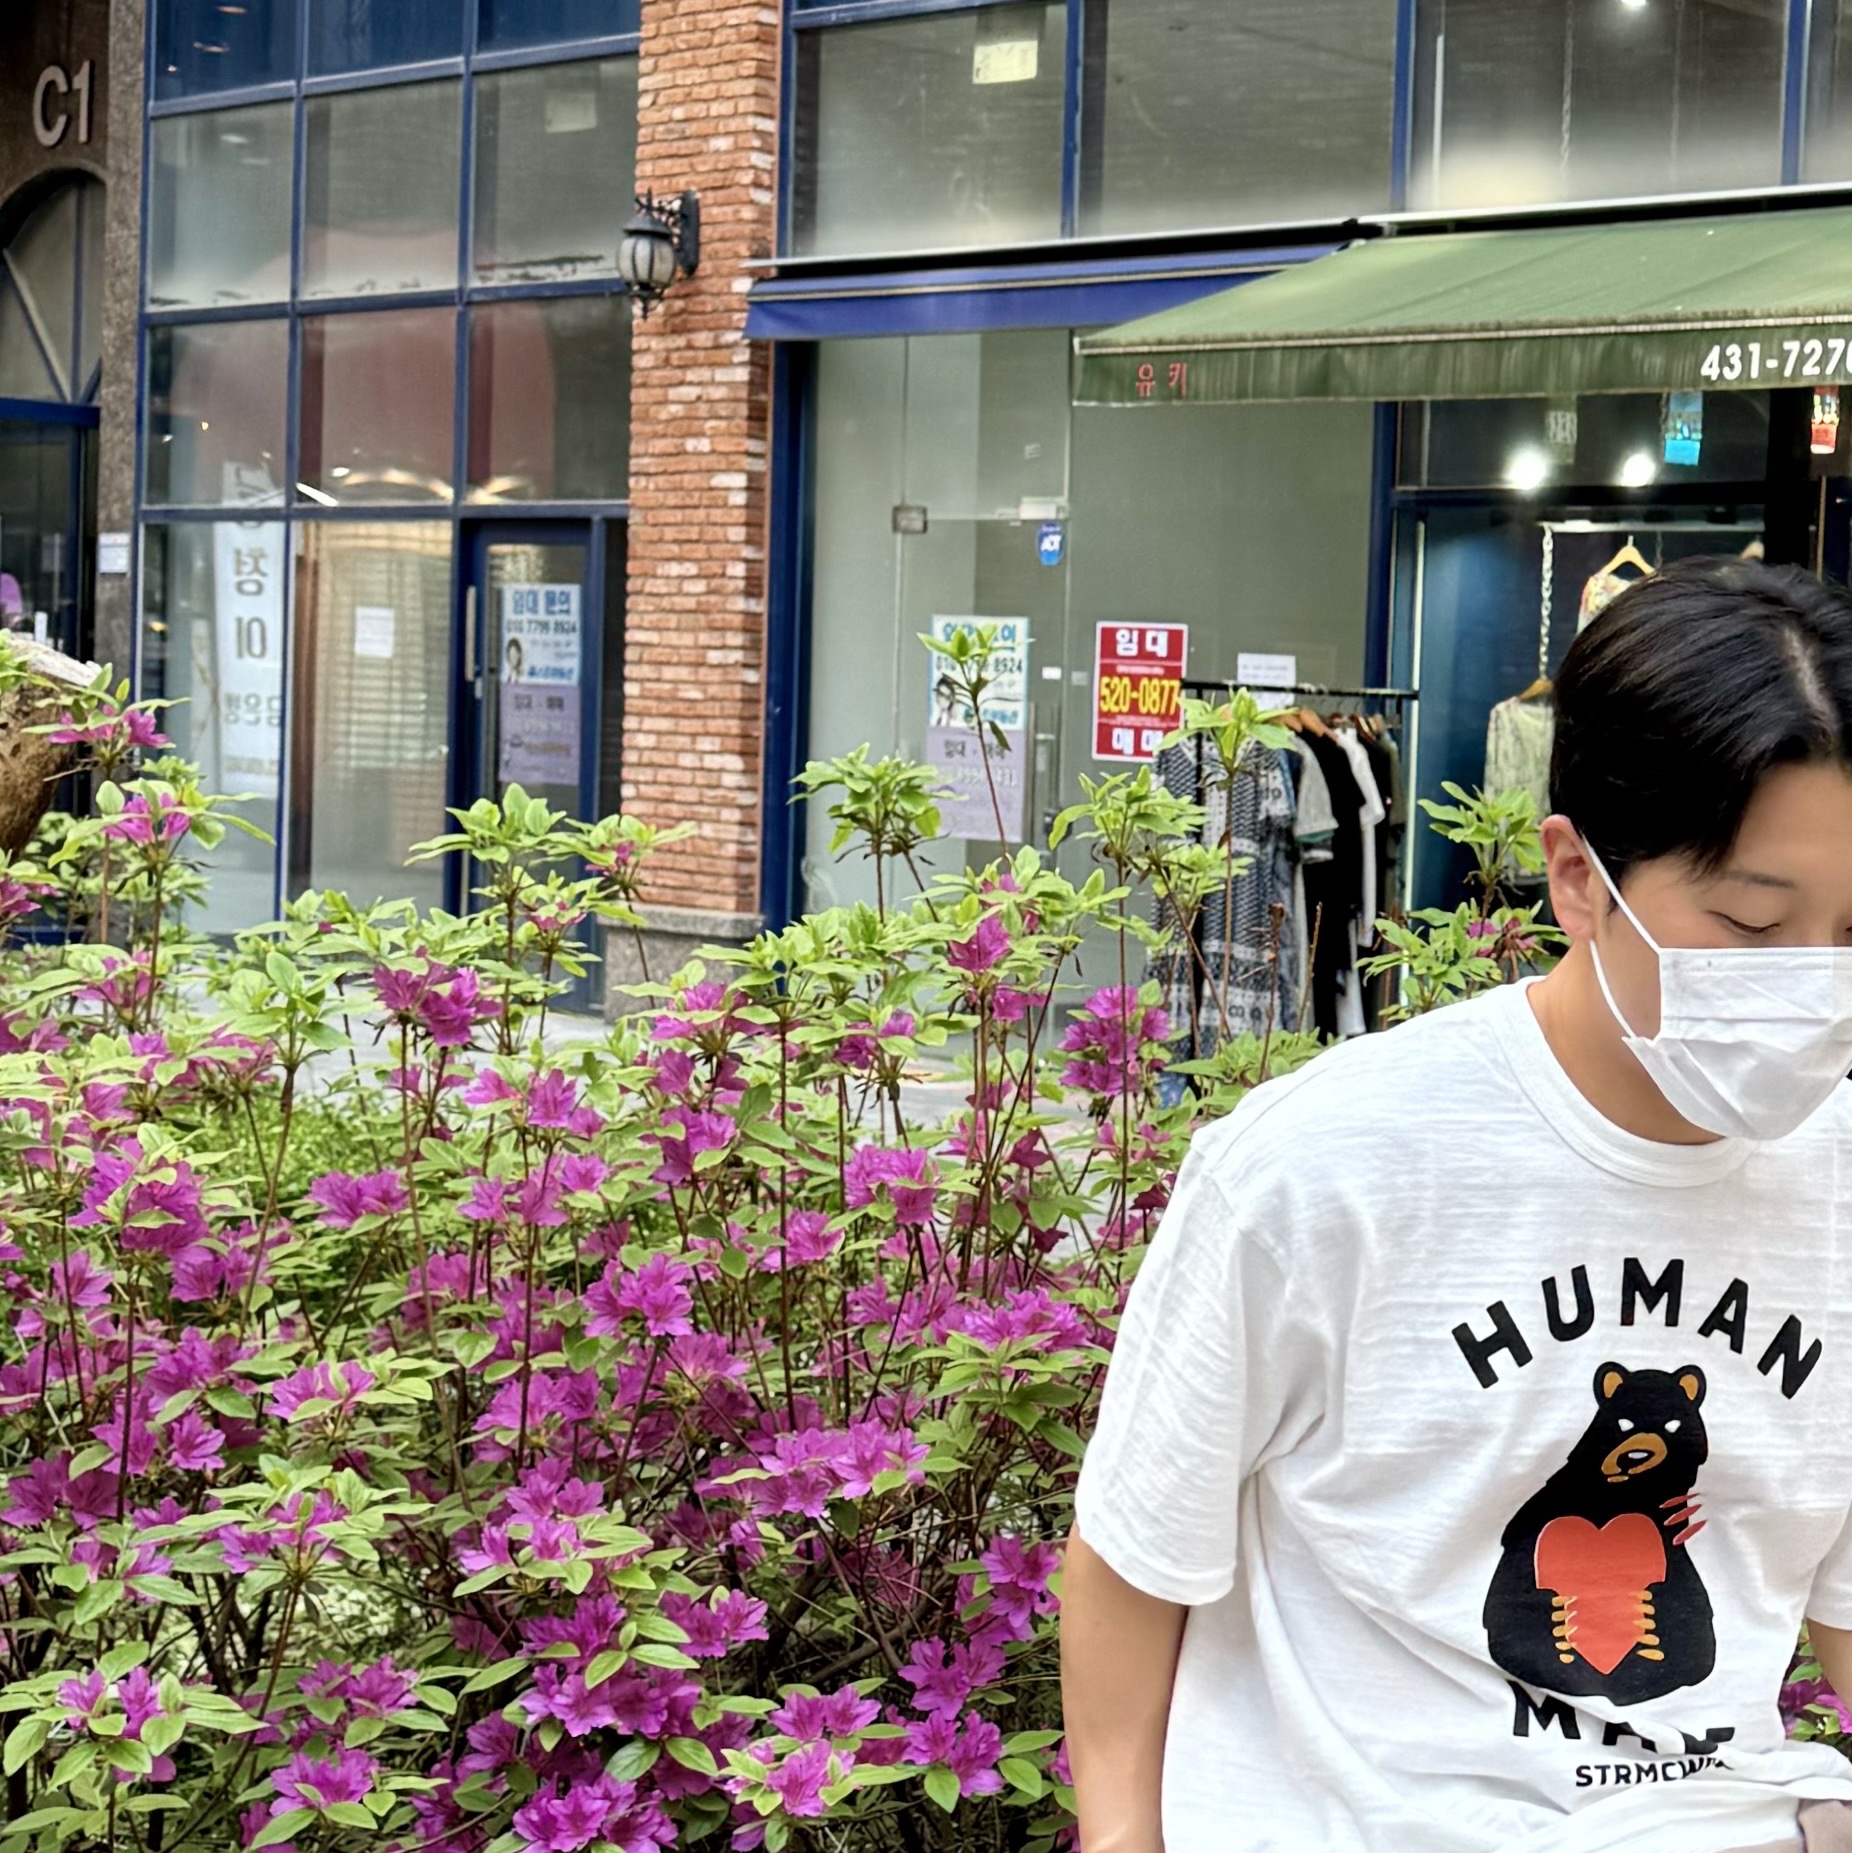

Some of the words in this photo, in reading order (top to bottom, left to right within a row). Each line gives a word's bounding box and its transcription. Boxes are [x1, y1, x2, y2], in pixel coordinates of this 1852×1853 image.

[32, 60, 91, 147] C1
[1115, 629, 1168, 658] 임대
[1099, 676, 1181, 715] 520-0877
[1451, 1257, 1822, 1400] HUMAN
